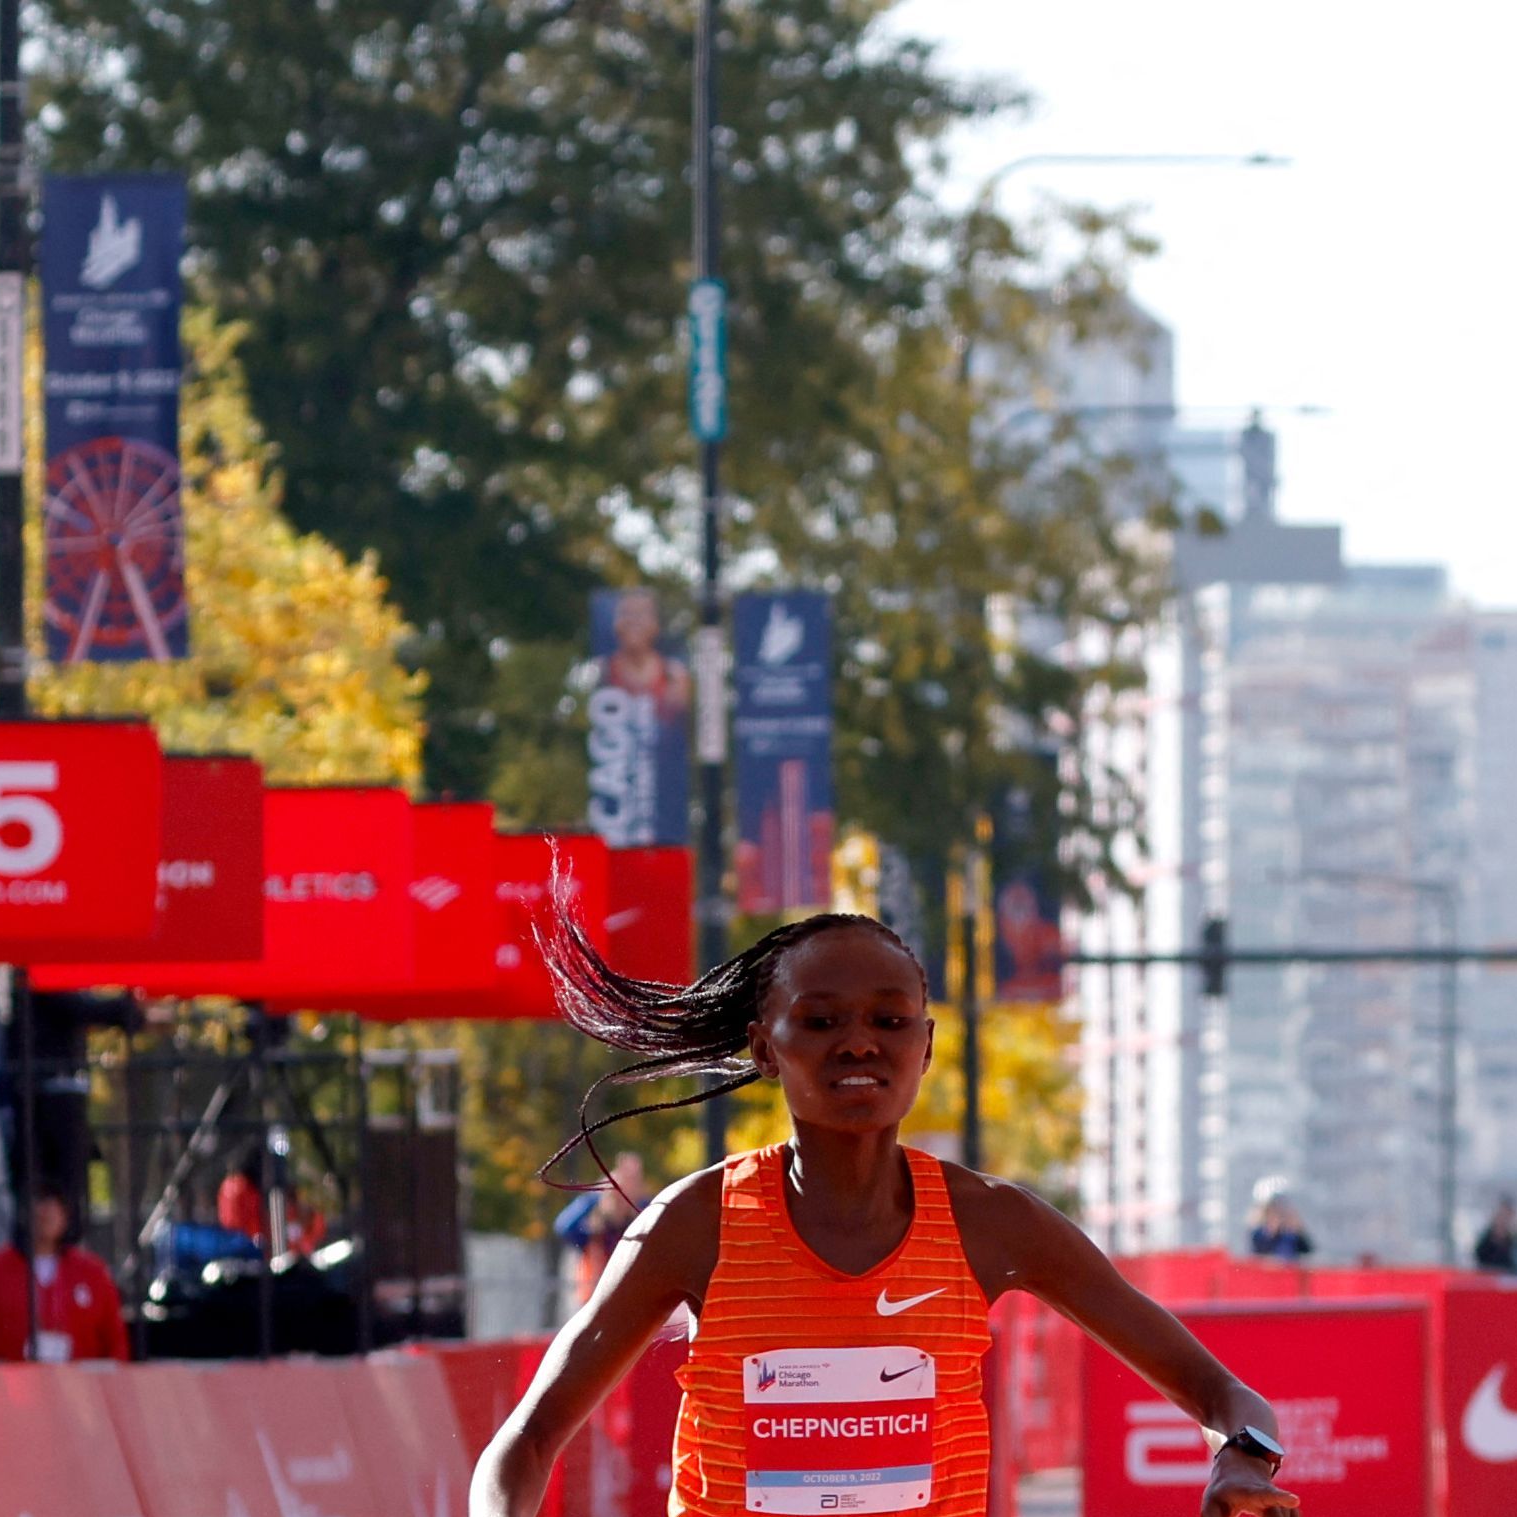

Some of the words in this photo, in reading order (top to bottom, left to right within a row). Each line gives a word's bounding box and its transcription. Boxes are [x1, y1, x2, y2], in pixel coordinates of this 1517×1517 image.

[778, 1371, 811, 1382] Chicago
[779, 1379, 820, 1388] Marathon
[752, 1413, 928, 1439] CHEPNGETICH
[803, 1473, 847, 1483] OCTOBER
